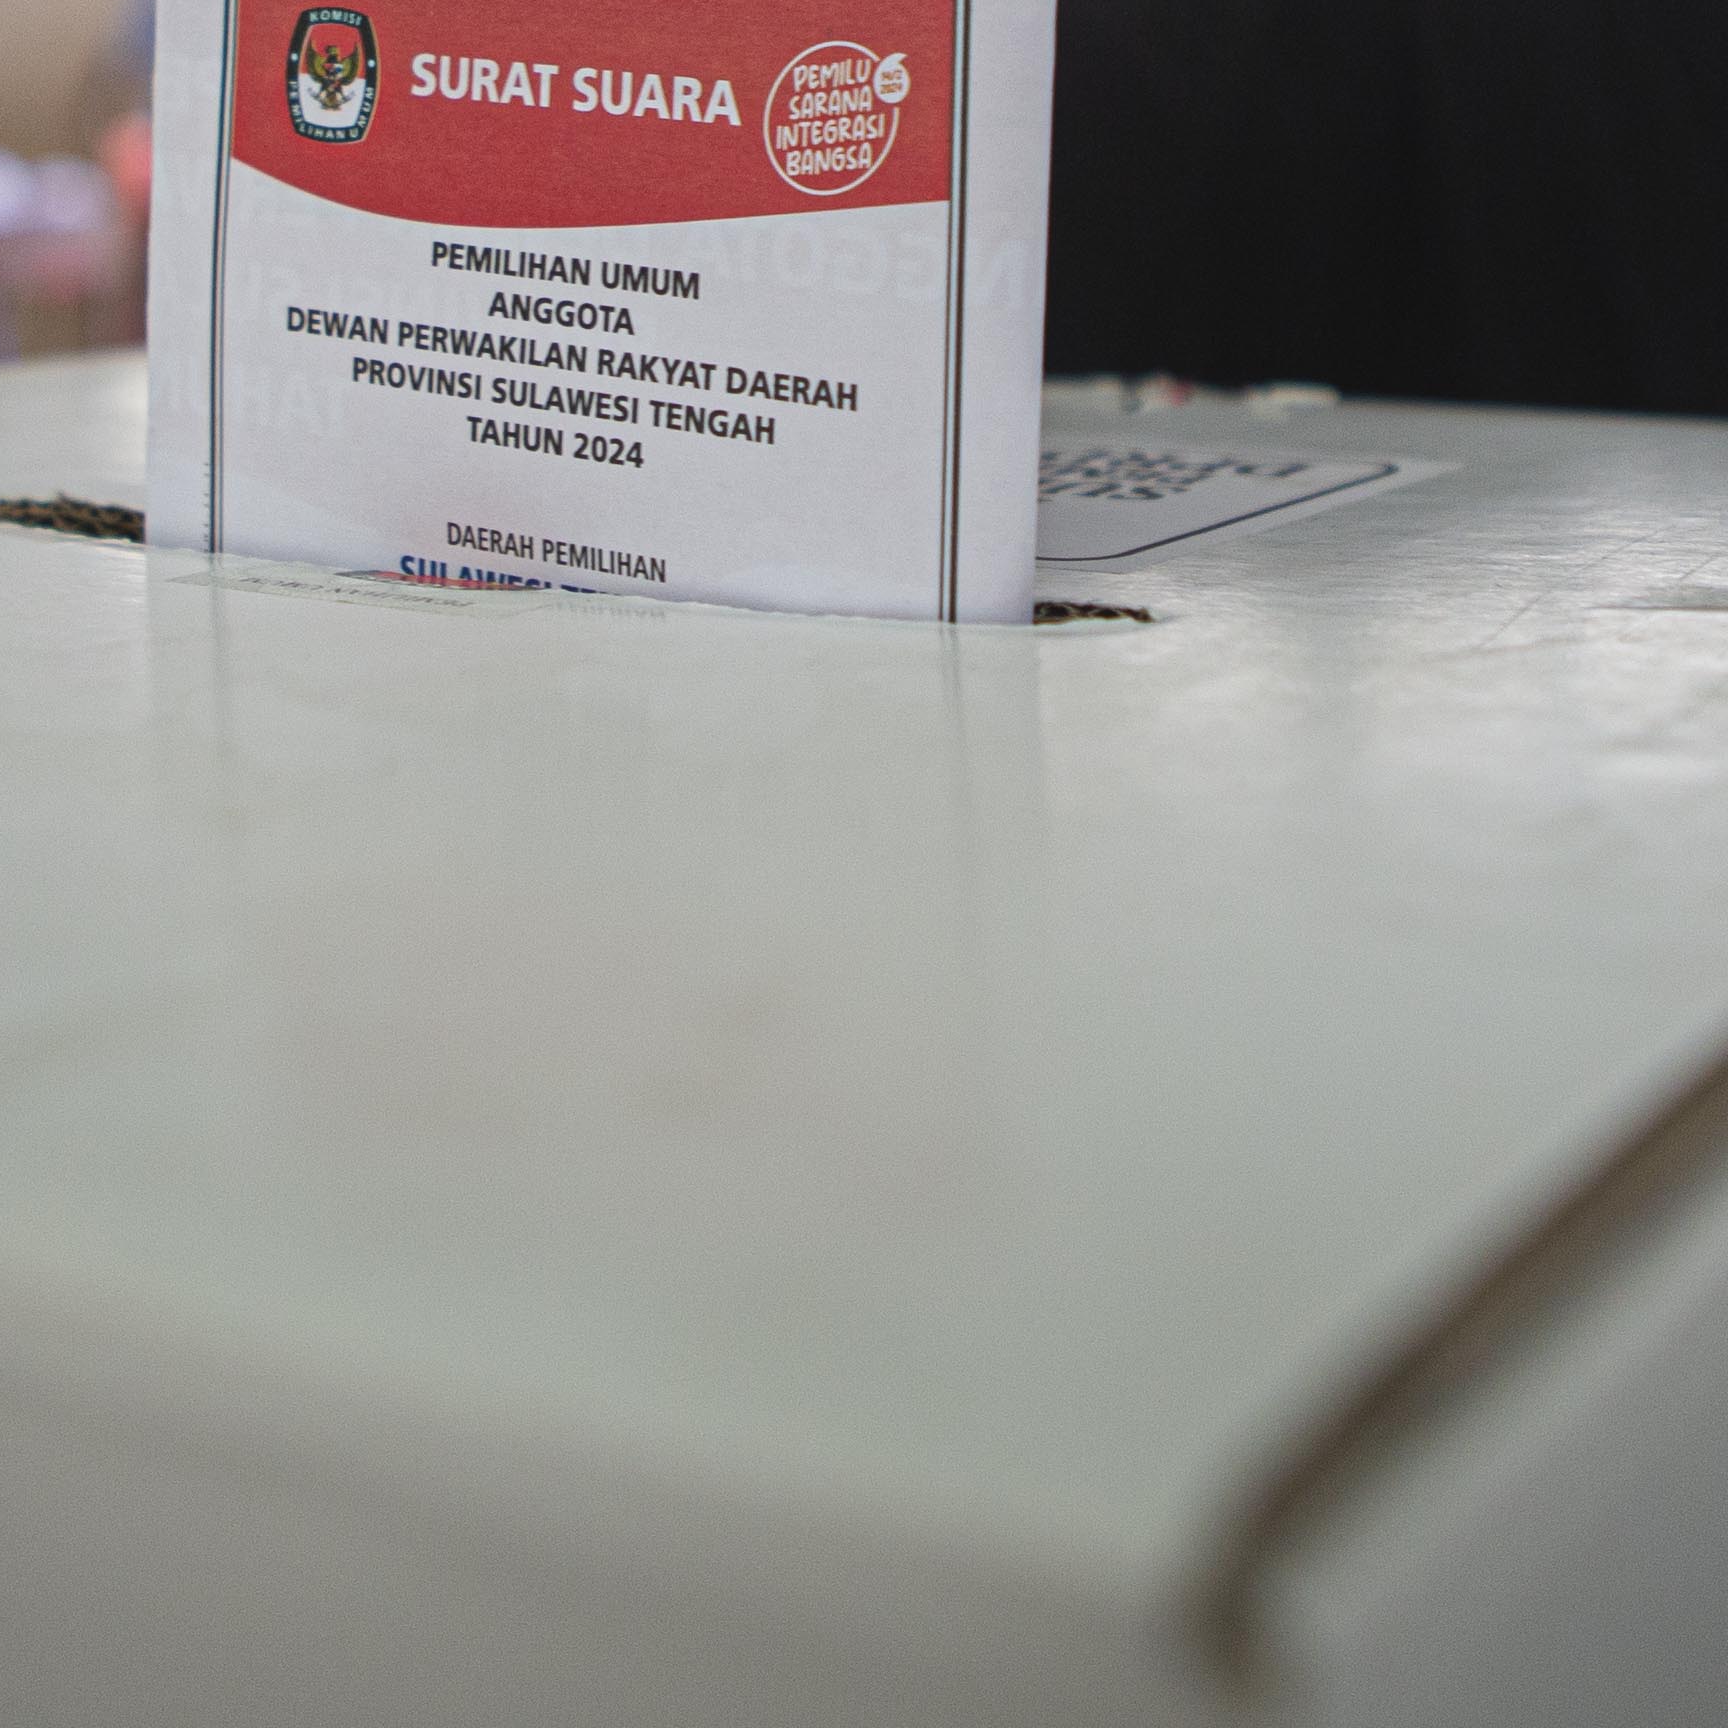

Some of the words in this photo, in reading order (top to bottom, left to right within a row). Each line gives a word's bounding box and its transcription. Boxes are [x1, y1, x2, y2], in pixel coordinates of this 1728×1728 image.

[309, 10, 363, 26] KOMISI
[411, 53, 560, 108] SURAT
[572, 67, 742, 126] SUARA
[793, 58, 871, 92] PEMILU
[789, 85, 872, 120] SARANA
[776, 113, 886, 151] INTEGRASI
[786, 142, 872, 176] BANGSA
[432, 241, 590, 286] PEMILIHAN
[602, 261, 700, 300] UMUM
[488, 292, 635, 336] ANGGOTA
[287, 306, 389, 345] DEWAN
[398, 321, 587, 373] PERWAKILAN
[597, 348, 717, 391] RAKYAT
[726, 366, 858, 412] DAERAH
[352, 357, 482, 401] PROVINSI
[492, 377, 639, 425] SULAWESI
[649, 399, 775, 445] TENGAH
[467, 416, 563, 456] TAHUN
[574, 432, 644, 469] 2024
[446, 522, 534, 560] DAERAH
[542, 538, 666, 583] PEMILIHAN
